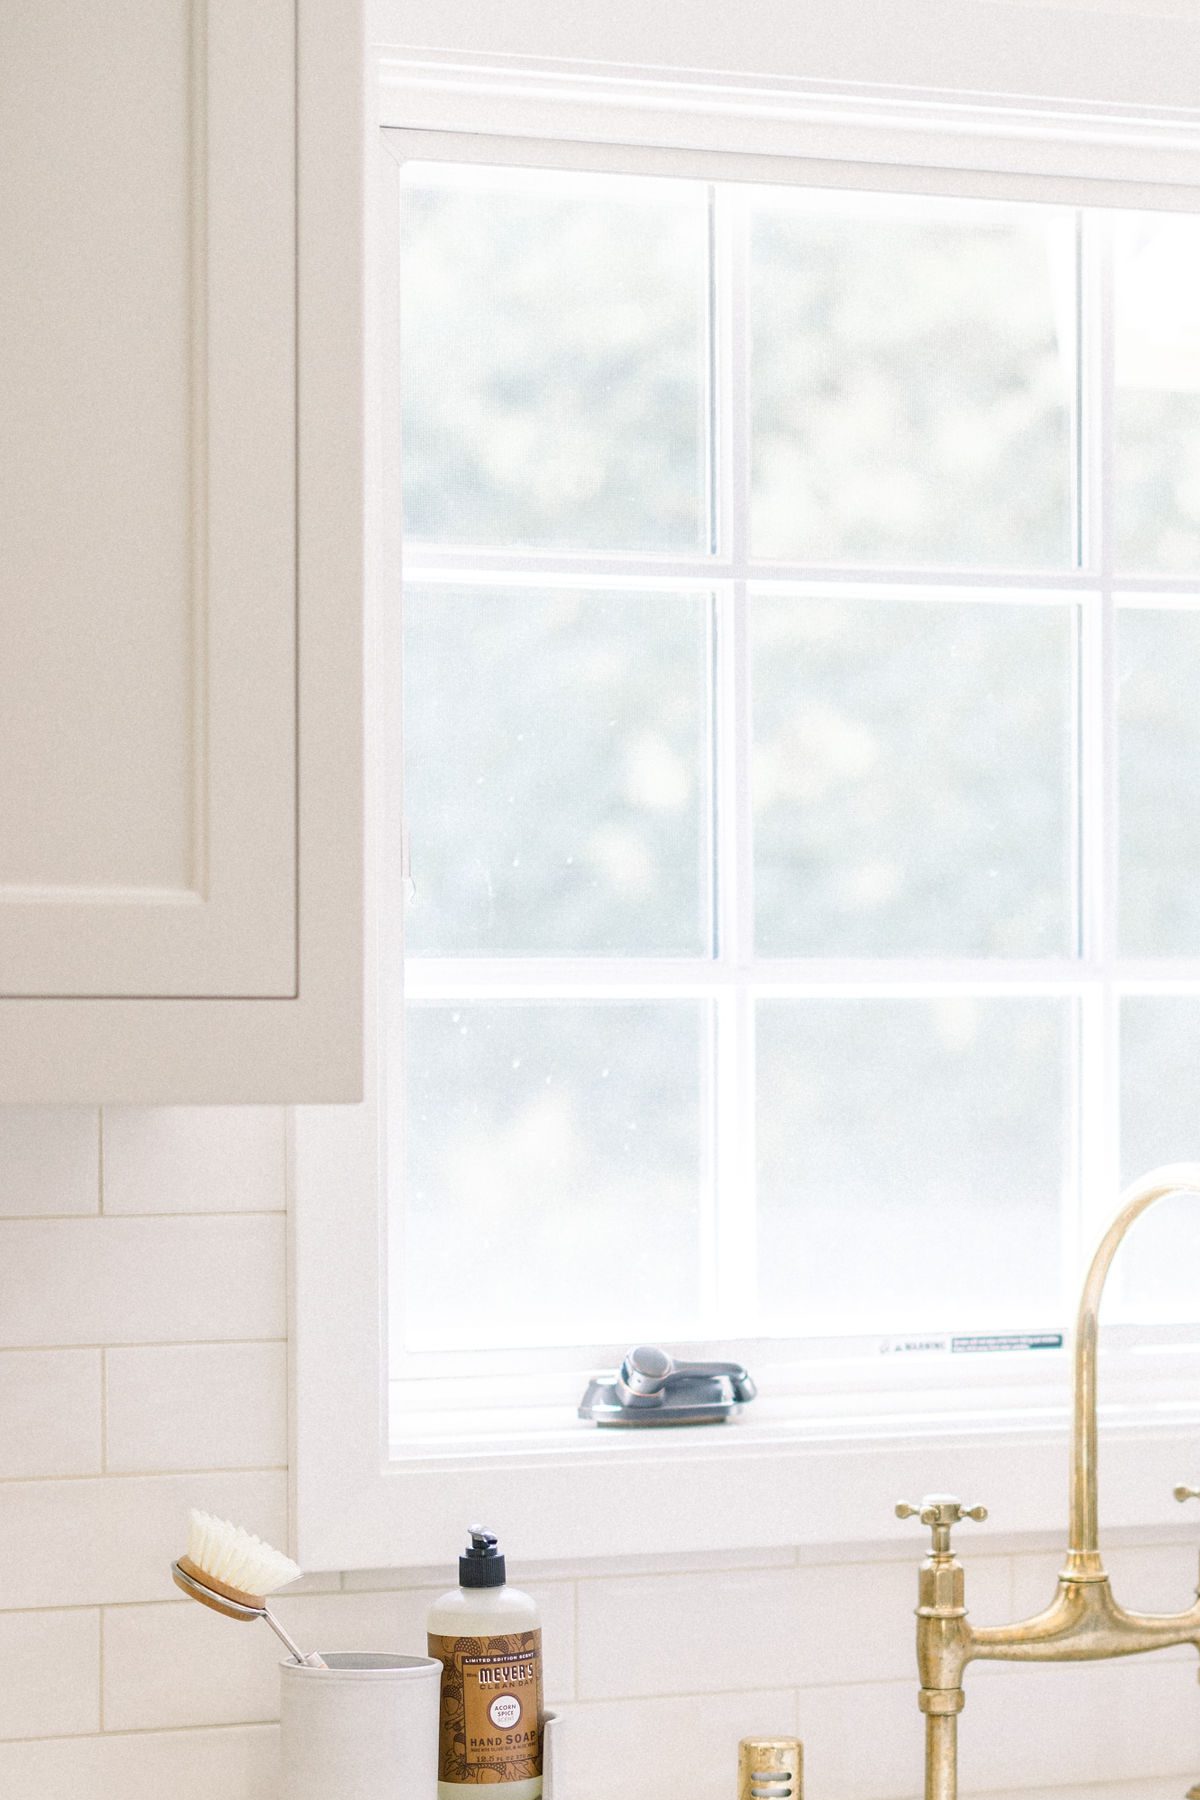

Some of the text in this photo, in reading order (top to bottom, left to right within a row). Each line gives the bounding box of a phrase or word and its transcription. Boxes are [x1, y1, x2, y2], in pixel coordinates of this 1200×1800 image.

[479, 1662, 533, 1684] MEYER'S
[480, 1682, 515, 1690] CLEAN
[470, 1731, 536, 1747] HAND SOAP
